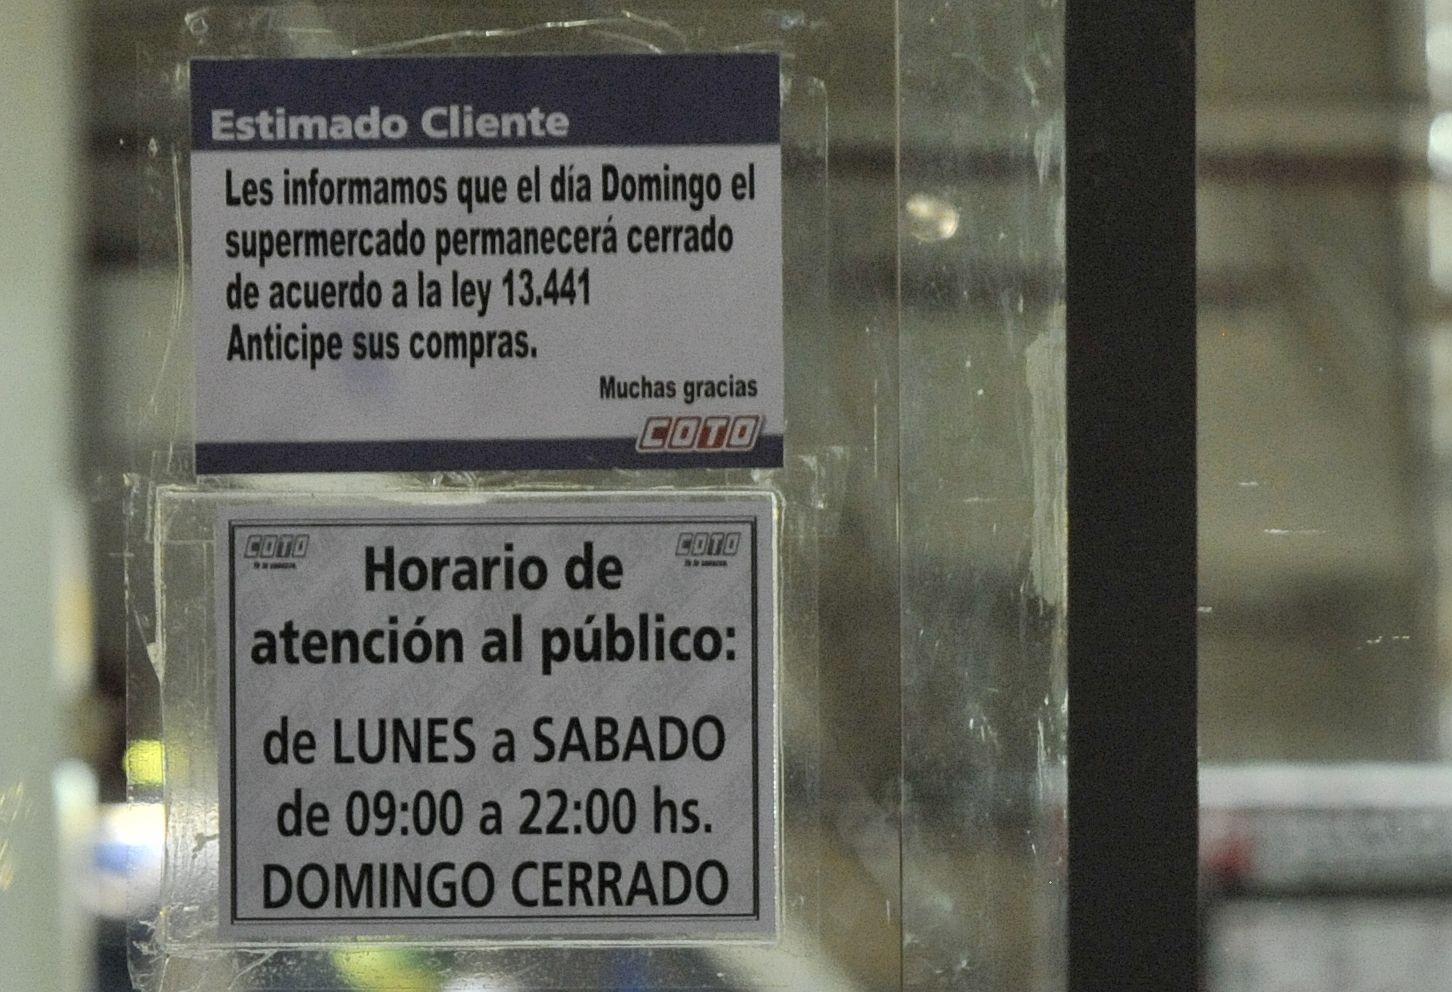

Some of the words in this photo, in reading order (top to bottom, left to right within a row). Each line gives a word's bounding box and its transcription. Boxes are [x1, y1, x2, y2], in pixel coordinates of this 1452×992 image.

[211, 108, 408, 142] Estimado
[422, 105, 570, 139] Cliente
[225, 169, 273, 206] Les
[283, 168, 446, 205] informamos
[458, 177, 507, 213] que
[518, 167, 541, 202] el
[551, 165, 591, 202] día
[602, 165, 721, 210] Domingo
[732, 164, 756, 200] el
[225, 221, 425, 267] supermercado
[436, 216, 618, 264] permanecerá
[627, 215, 733, 253] cerrado
[226, 273, 259, 309] de
[270, 272, 382, 308] acuerdo
[392, 279, 407, 308] a
[417, 271, 442, 307] la
[452, 270, 491, 316] ley
[502, 268, 591, 306] 13.441
[227, 324, 342, 369] Anticipe
[353, 331, 400, 359] sus
[409, 329, 538, 368] compras.
[600, 375, 676, 400] Muchas
[684, 375, 757, 405] gracias
[636, 415, 765, 453] COTO
[244, 534, 310, 559] COTO
[364, 543, 547, 591] Horario
[564, 542, 623, 590] de
[675, 532, 741, 557] COTO
[251, 615, 463, 664] atención
[482, 614, 523, 663] al
[542, 612, 736, 675] público:
[263, 717, 316, 765] de
[334, 717, 475, 764] LUNES
[493, 727, 517, 763] a
[532, 714, 725, 763] SABADO
[276, 789, 330, 837] de
[345, 790, 462, 836] 09:00
[479, 800, 502, 835] a
[519, 788, 636, 835] 22:00
[653, 786, 713, 834] hs.
[263, 862, 494, 909] DOMINGO
[511, 859, 728, 907] CERRADO
